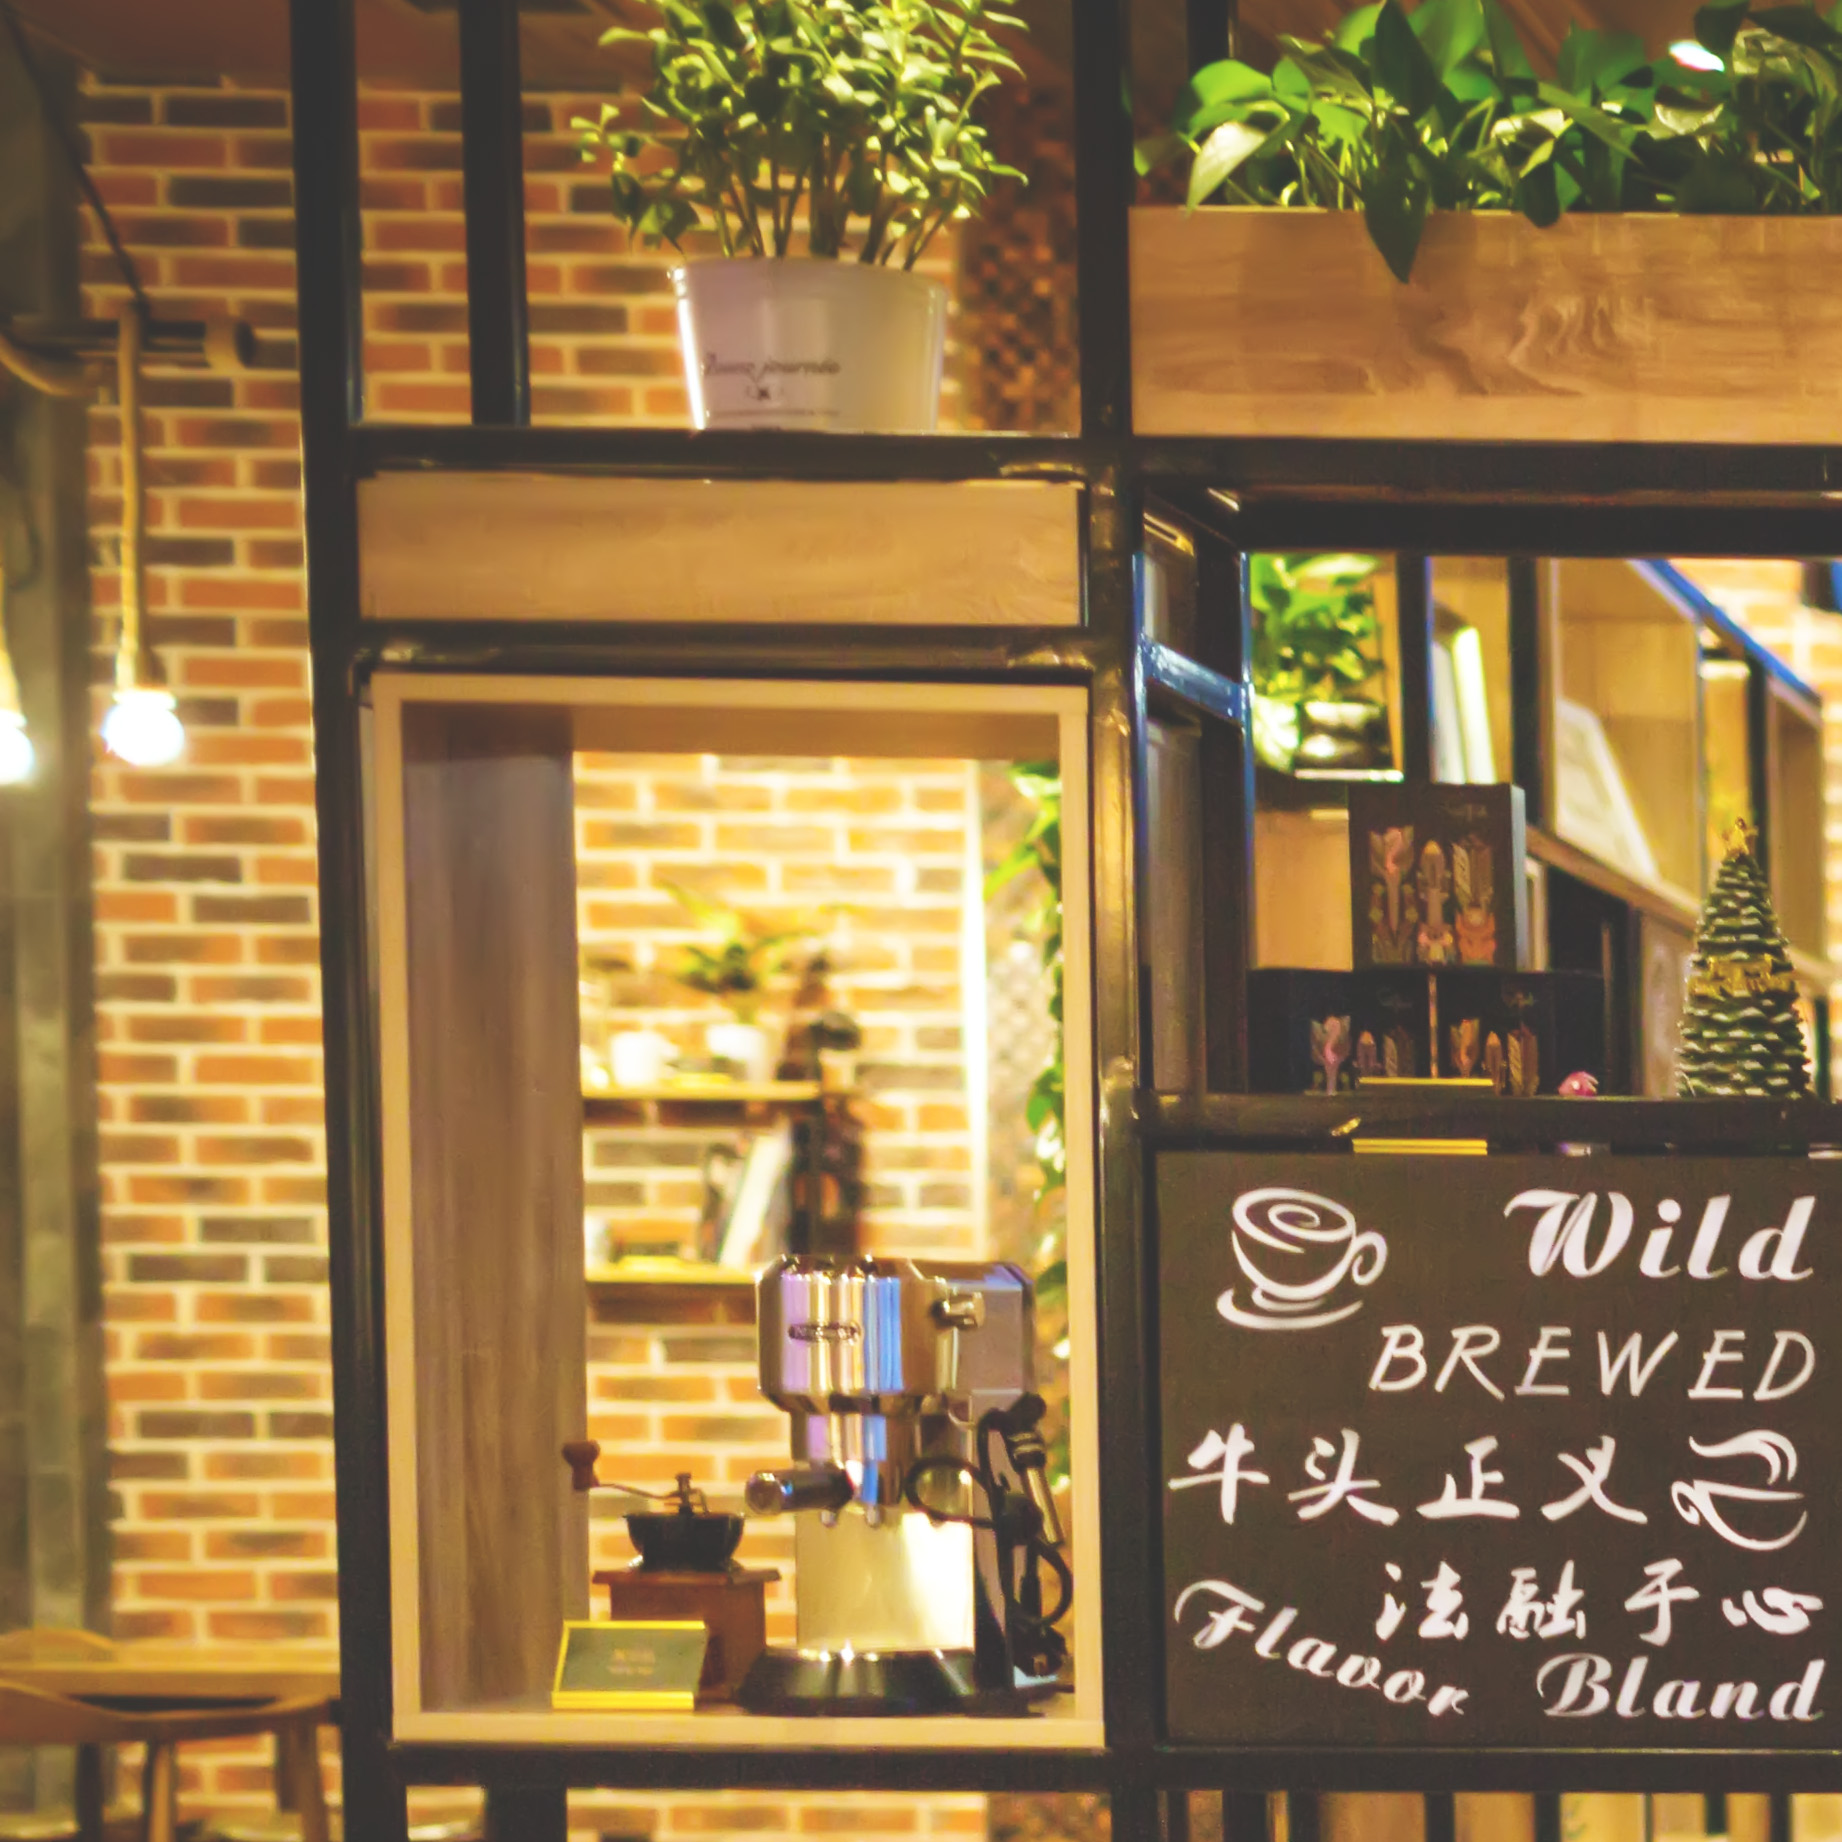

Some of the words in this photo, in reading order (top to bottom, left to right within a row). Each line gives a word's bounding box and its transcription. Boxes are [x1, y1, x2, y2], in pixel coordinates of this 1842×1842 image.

[1504, 1189, 1815, 1280] Wild
[1369, 1324, 1815, 1400] BREWED
[1168, 1423, 1647, 1526] 牛头正义
[1376, 1559, 1823, 1645] 法融于心
[1175, 1579, 1469, 1715] Flavor
[1537, 1654, 1825, 1720] Bland
